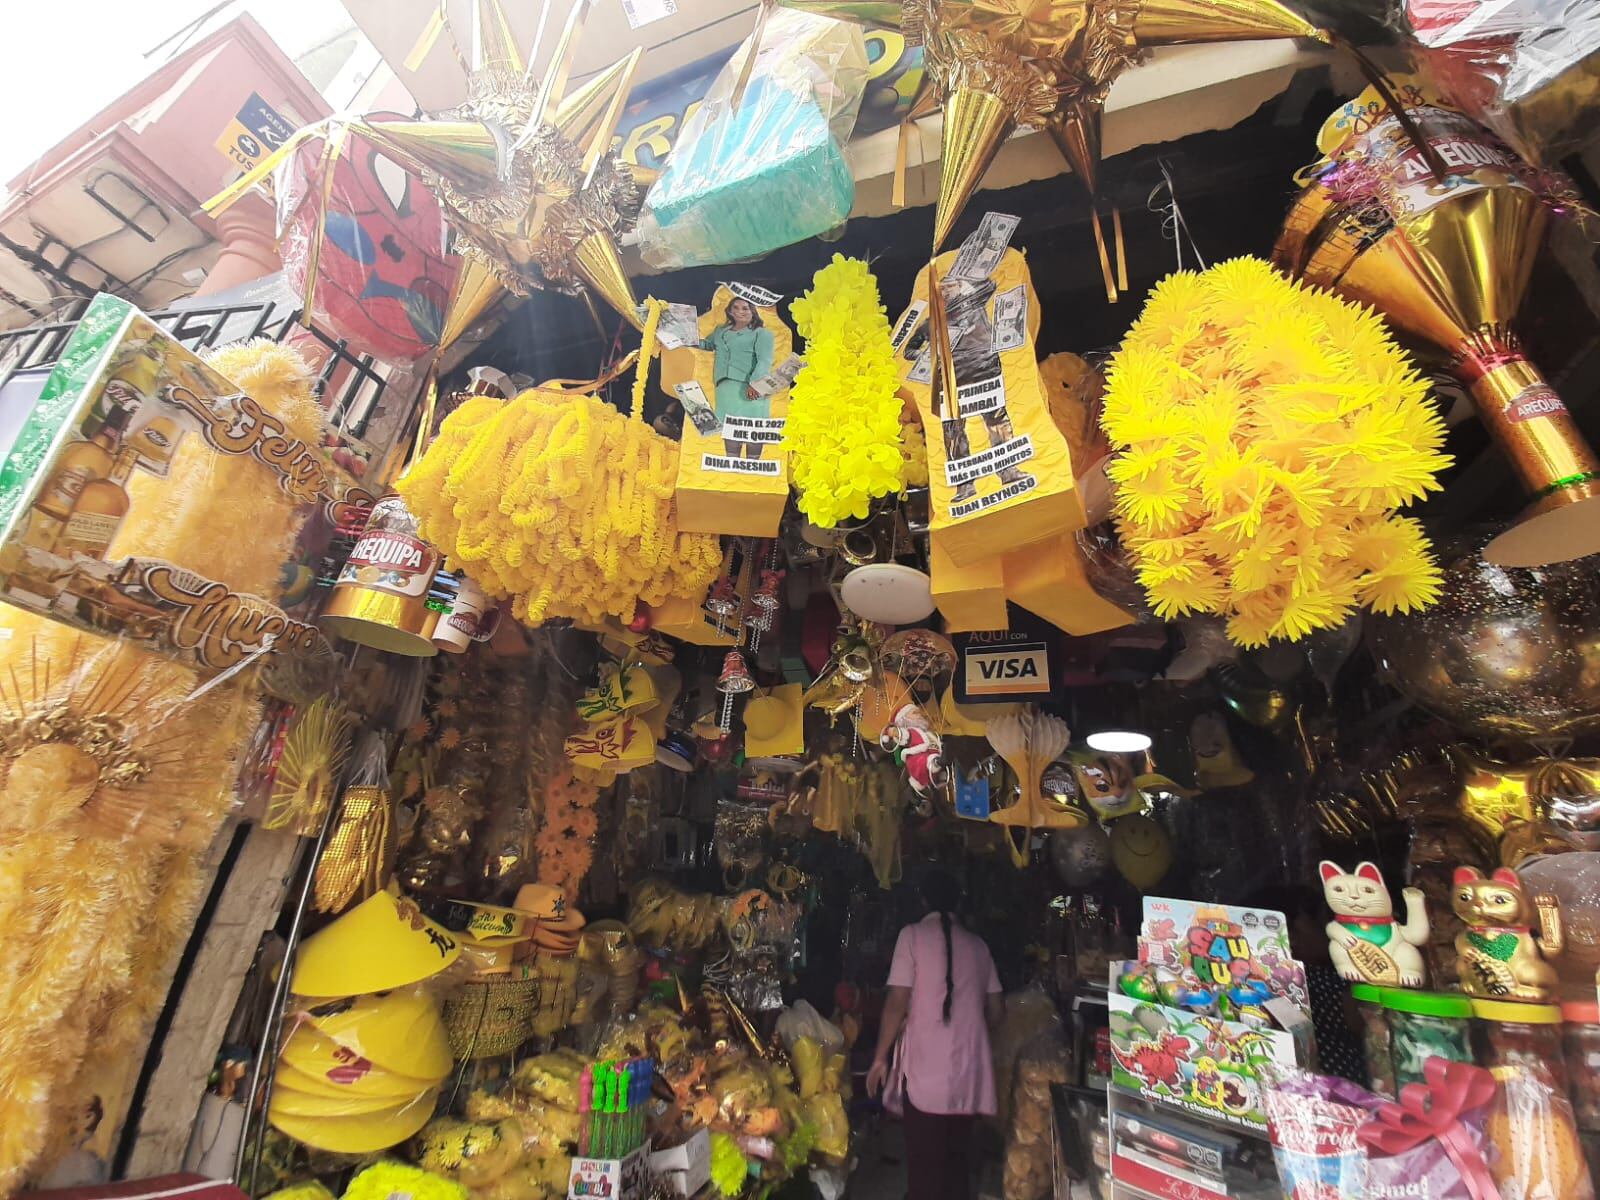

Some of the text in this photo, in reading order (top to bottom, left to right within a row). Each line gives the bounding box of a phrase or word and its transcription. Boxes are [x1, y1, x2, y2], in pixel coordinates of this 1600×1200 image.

[258, 107, 292, 139] AGENT
[957, 379, 1002, 399] PRIMERA
[726, 416, 785, 429] HASTA EL 202
[733, 429, 785, 442] ME QUED
[704, 456, 777, 473] DINA ASESINA
[947, 437, 1029, 472] EL PERUANO NO DURA
[970, 468, 981, 478] DE
[982, 466, 993, 475] 60
[994, 448, 1032, 471] MINUTOS
[951, 477, 1035, 517] JUAN REYNOSO
[350, 538, 422, 568] AREQUIPA
[1010, 632, 1028, 640] CON
[976, 658, 1038, 679] VISA
